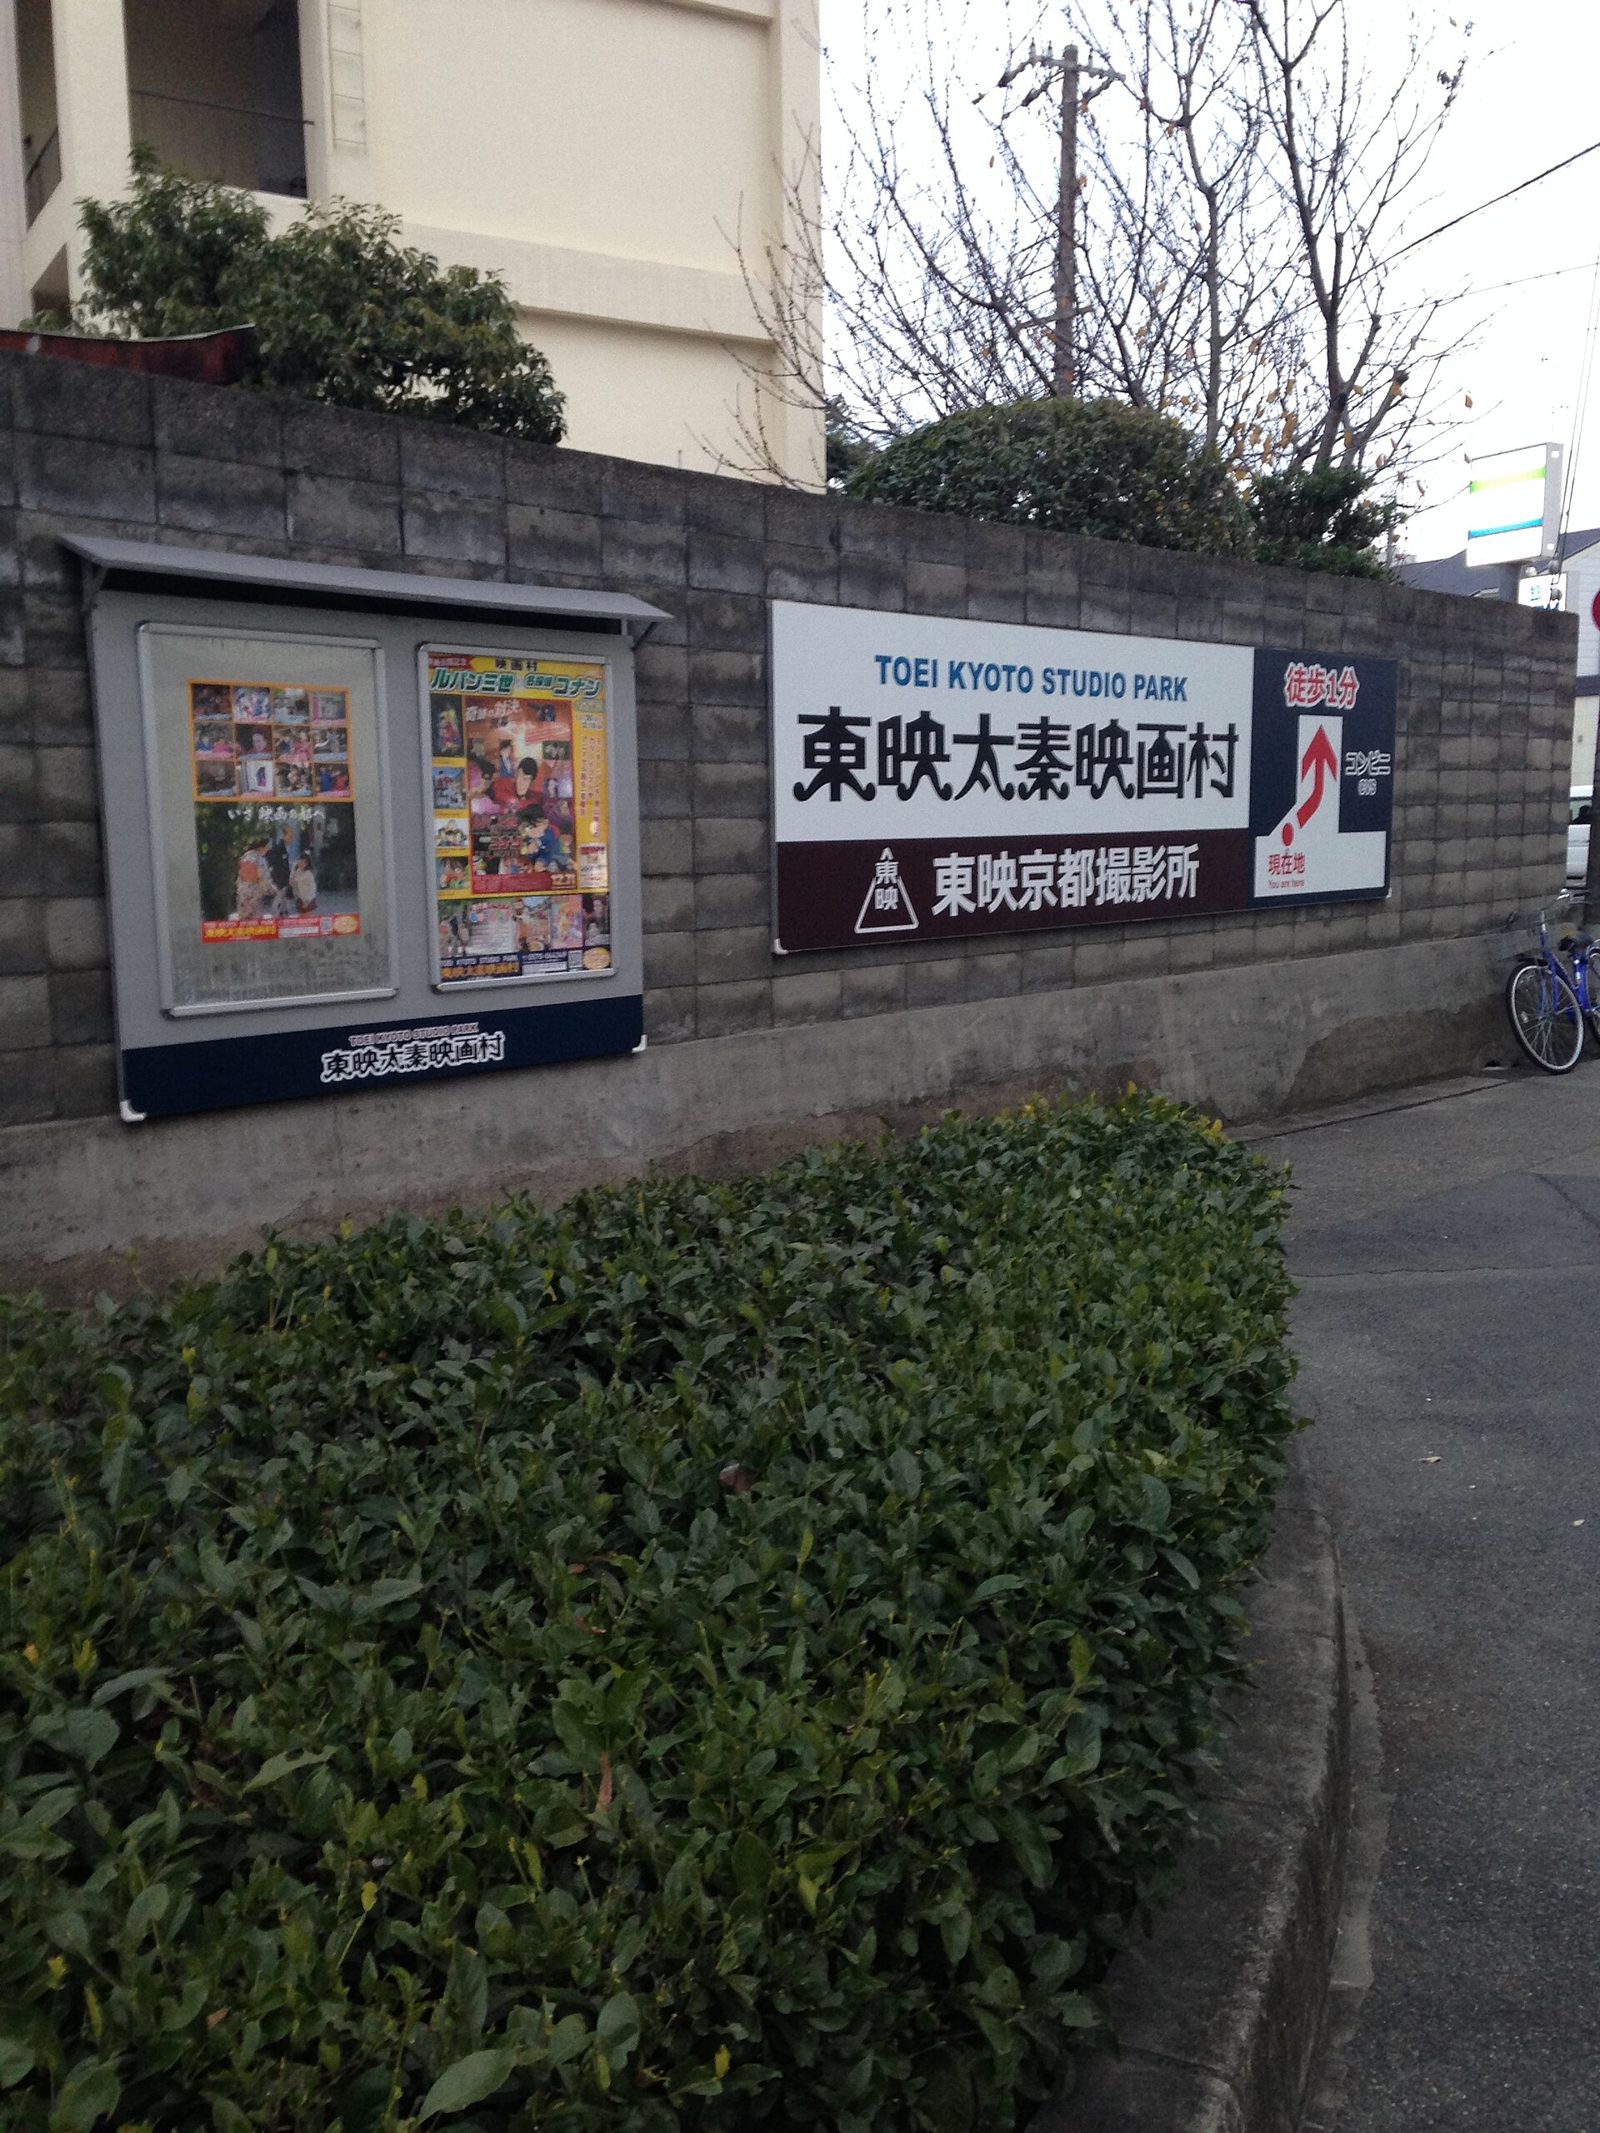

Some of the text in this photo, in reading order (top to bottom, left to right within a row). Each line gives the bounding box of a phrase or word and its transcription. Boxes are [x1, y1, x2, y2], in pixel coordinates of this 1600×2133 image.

[431, 667, 515, 695] ルパン三世
[875, 655, 1188, 701] TOEI KYOTO STUDIO PARK
[1285, 663, 1359, 708] 徒歩1分
[793, 706, 1240, 802] 東映太秦映画村
[1345, 750, 1391, 776] コンビニ
[874, 860, 899, 911] 東映
[931, 843, 1200, 917] 東映京都撮影所
[1268, 851, 1305, 876] 現在地
[1268, 879, 1280, 889] You
[349, 1022, 480, 1046] TOEI KYOTO STUDIO PARK
[321, 1031, 505, 1083] 東映太秦映画村
